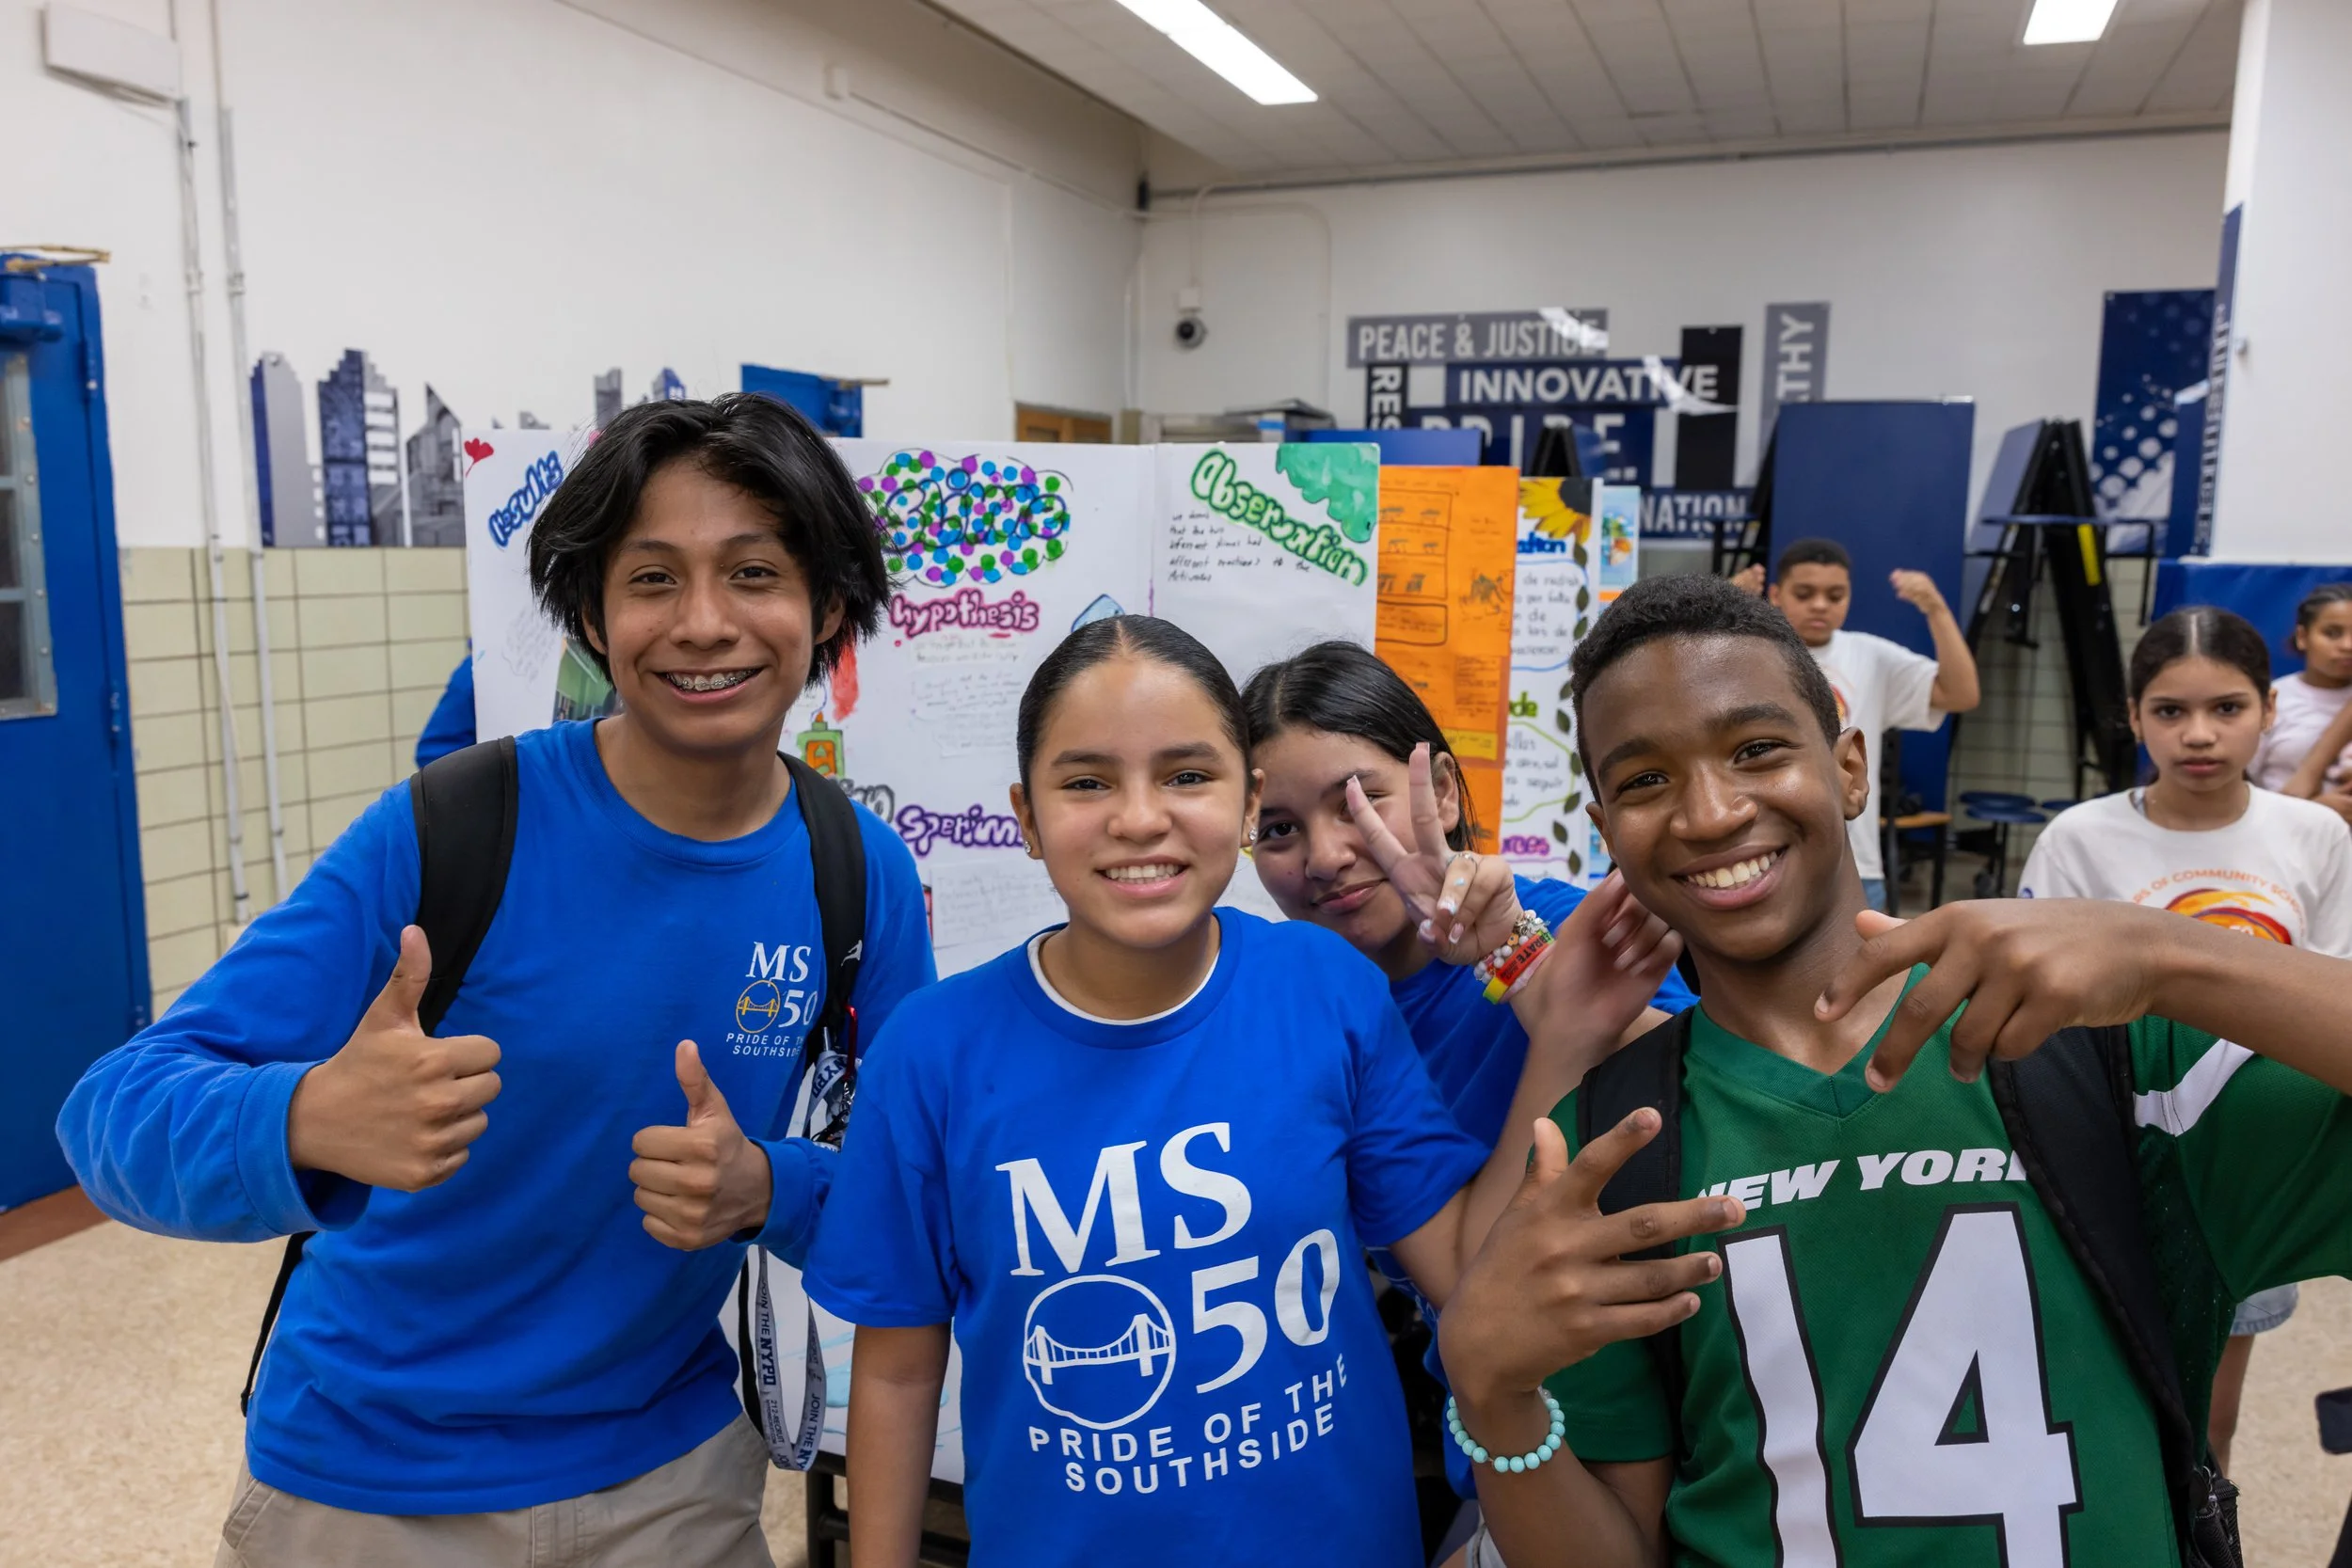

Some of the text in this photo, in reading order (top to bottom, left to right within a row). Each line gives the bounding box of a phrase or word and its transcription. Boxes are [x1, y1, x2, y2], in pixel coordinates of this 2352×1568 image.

[1359, 319, 1599, 360] PEACE & JUSTIC
[1777, 311, 1814, 402] THY
[890, 588, 1040, 640] hypothesis
[745, 941, 812, 983] MS
[778, 990, 818, 1028] 50
[725, 1033, 770, 1045] PRIDE
[773, 1036, 790, 1046] OF
[994, 1122, 1252, 1276] MS
[1190, 1228, 1341, 1394] 50
[760, 1337, 777, 1386] NYPD
[1716, 1200, 2084, 1568] 14
[809, 1393, 820, 1422] JOIN
[1028, 1353, 1347, 1463] PRIDE OF THE
[803, 1423, 817, 1449] THE
[1065, 1402, 1334, 1496] SOUTHSIDE
